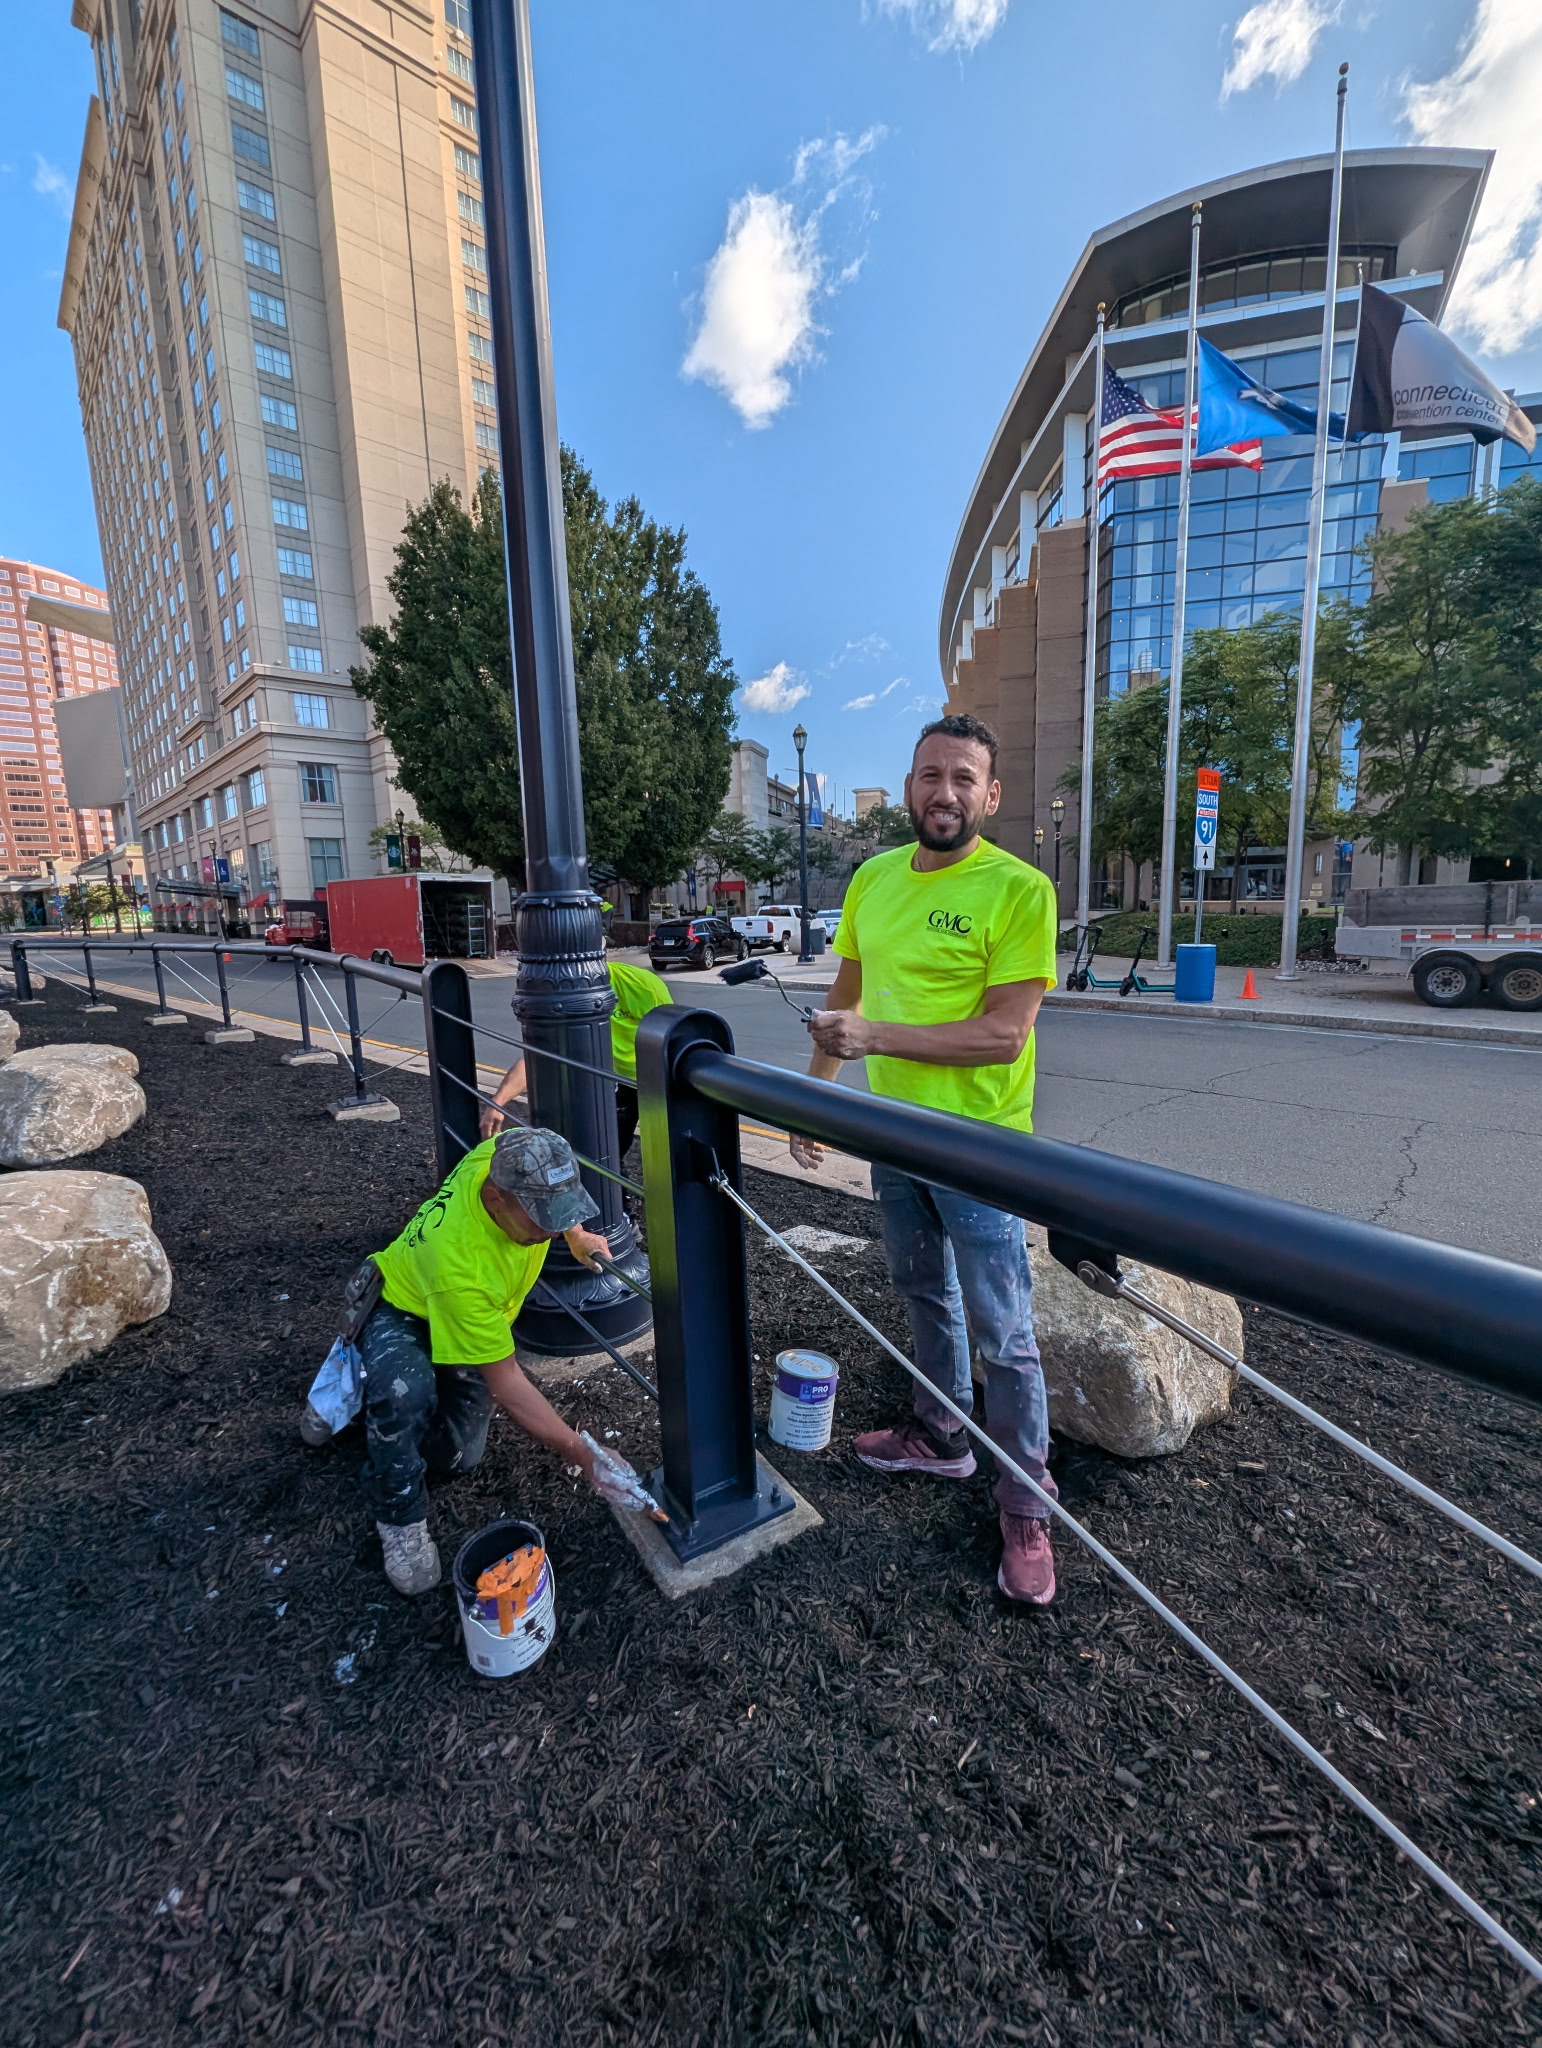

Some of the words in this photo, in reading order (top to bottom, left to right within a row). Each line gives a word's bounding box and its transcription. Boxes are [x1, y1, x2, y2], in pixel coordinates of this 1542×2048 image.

[1198, 793, 1218, 806] SOUTH
[1201, 820, 1212, 839] 91
[928, 909, 972, 934] GMC
[812, 1385, 829, 1394] PRO
